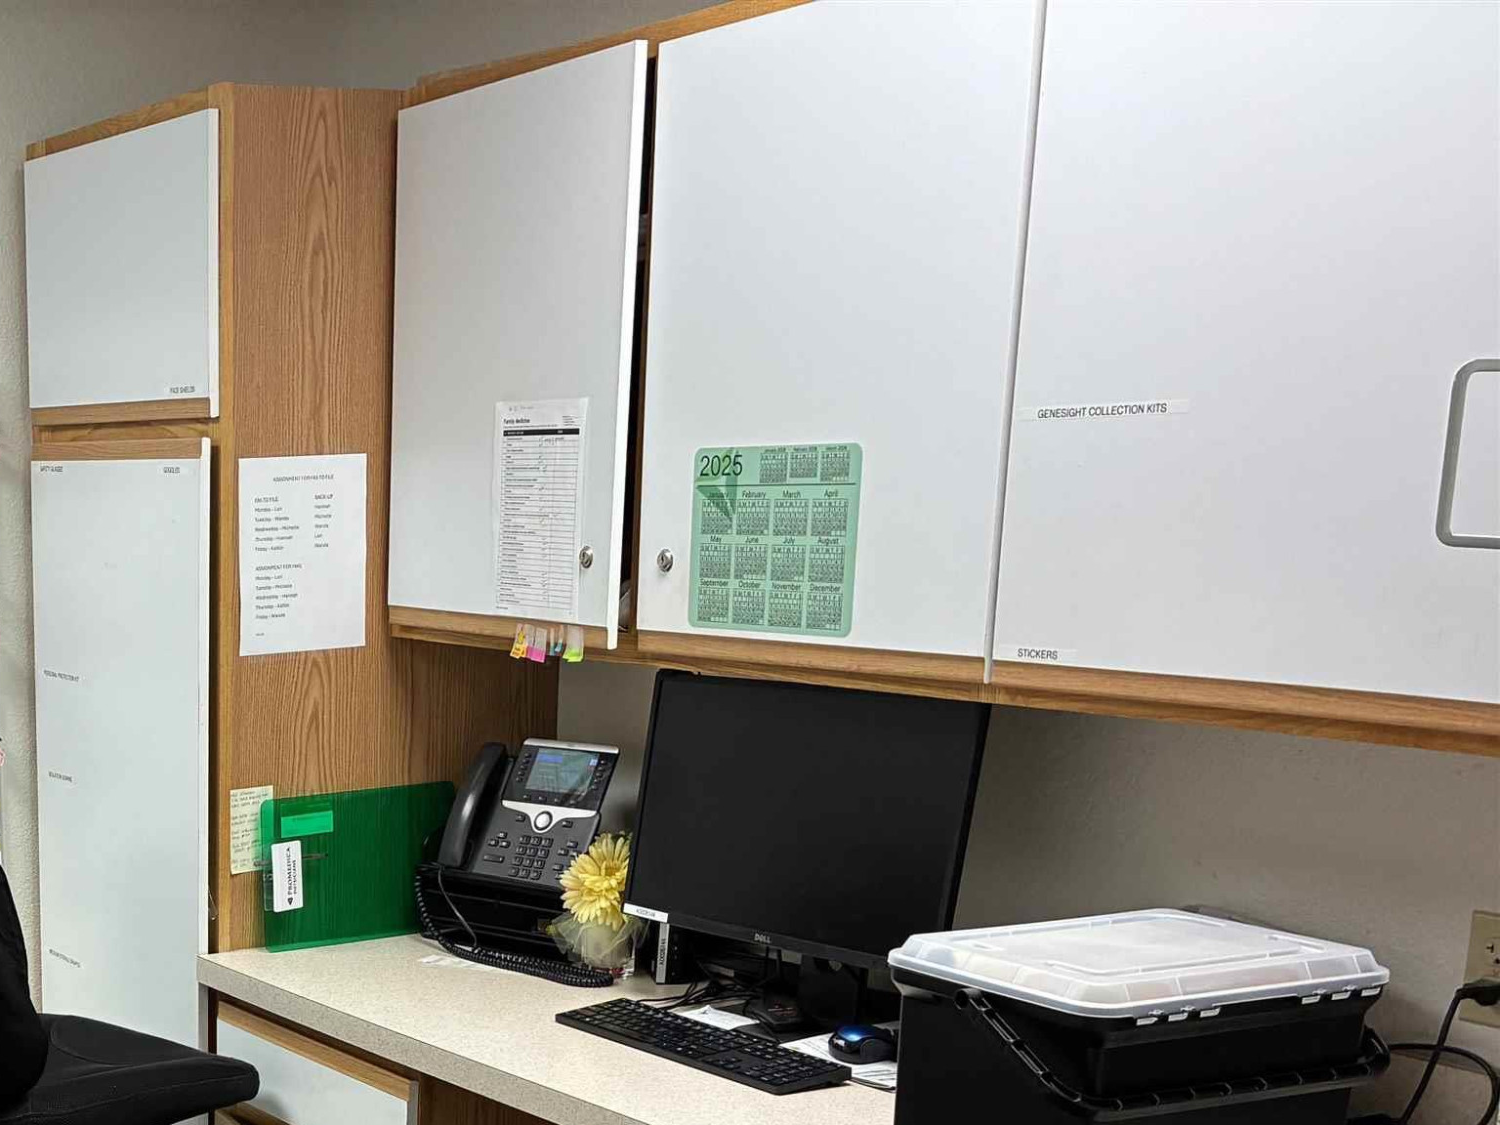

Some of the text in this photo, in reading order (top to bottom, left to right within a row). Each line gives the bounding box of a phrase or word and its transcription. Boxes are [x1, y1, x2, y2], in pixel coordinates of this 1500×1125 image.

[1037, 402, 1168, 419] GENESIGHT COLLECTION KITS
[700, 454, 743, 477] 2025
[742, 490, 767, 499] February
[782, 490, 801, 498] March
[824, 489, 839, 499] April
[710, 535, 722, 544] May
[745, 536, 759, 544] June
[783, 536, 796, 545] July
[817, 536, 839, 546] August
[700, 578, 729, 587] September
[738, 580, 761, 589] October
[771, 581, 801, 591] November
[809, 583, 841, 592] December
[1017, 647, 1059, 661] STICKERS
[754, 933, 772, 944] DELL
